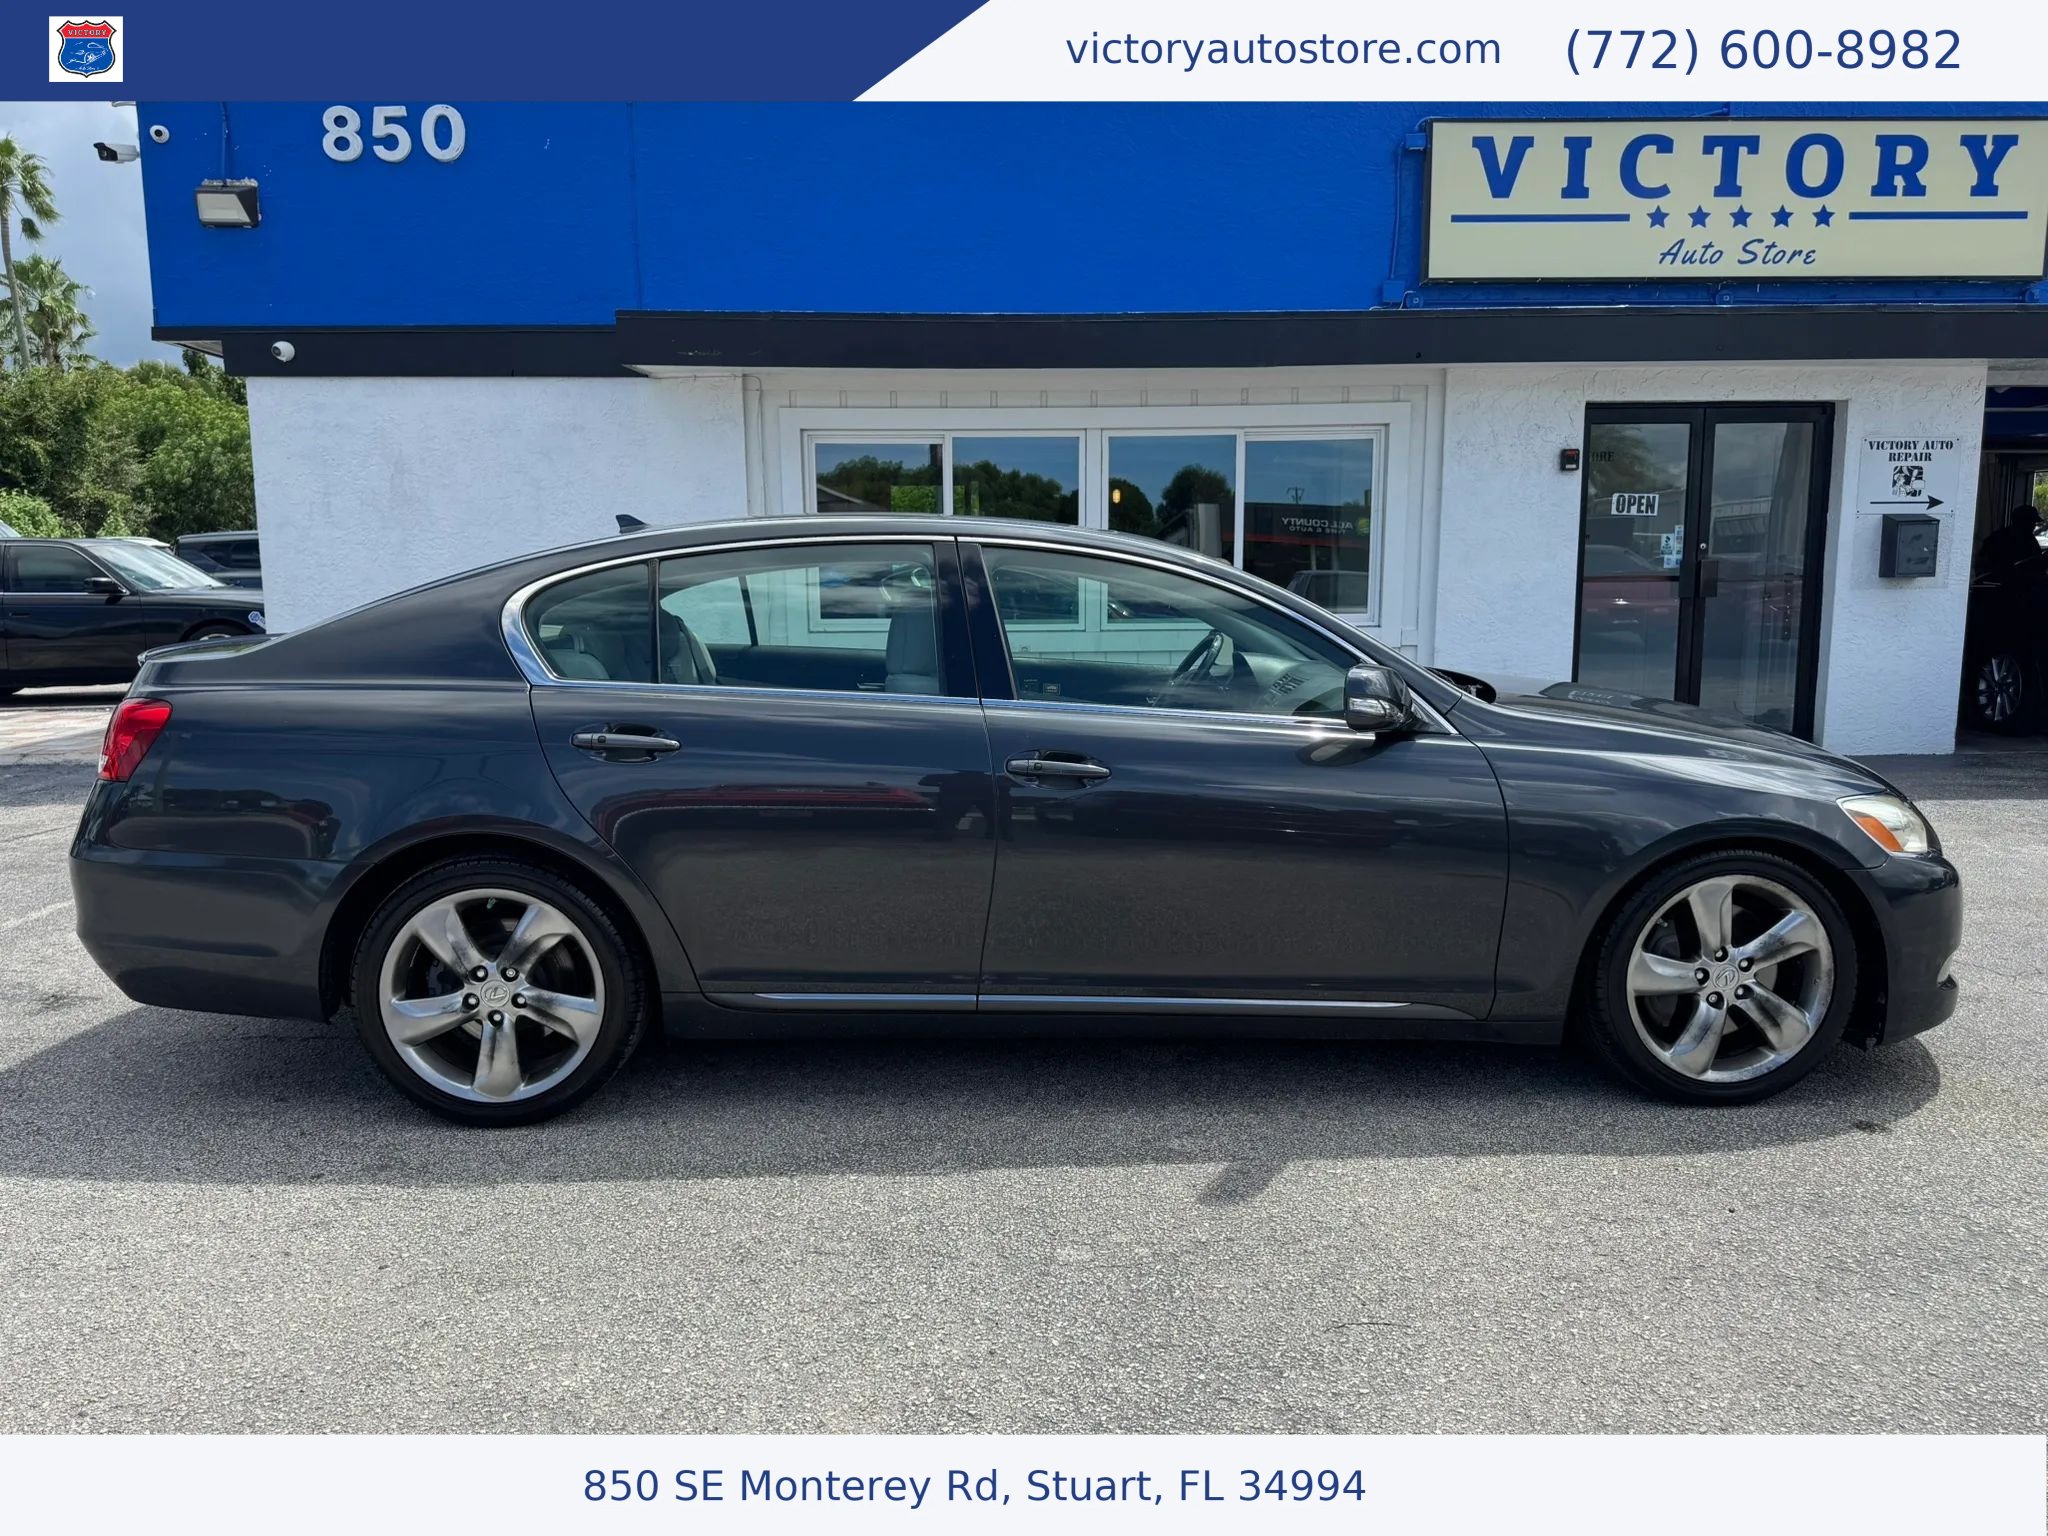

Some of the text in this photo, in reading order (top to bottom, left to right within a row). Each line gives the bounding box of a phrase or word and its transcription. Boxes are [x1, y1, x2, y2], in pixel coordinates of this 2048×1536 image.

[322, 104, 466, 162] 850
[1472, 133, 2019, 199] VICTORY
[1658, 237, 1817, 266] Auto Store
[1868, 440, 1954, 451] VICTORY AUTO
[1888, 452, 1932, 462] REPAIR
[1614, 494, 1657, 515] OPEN
